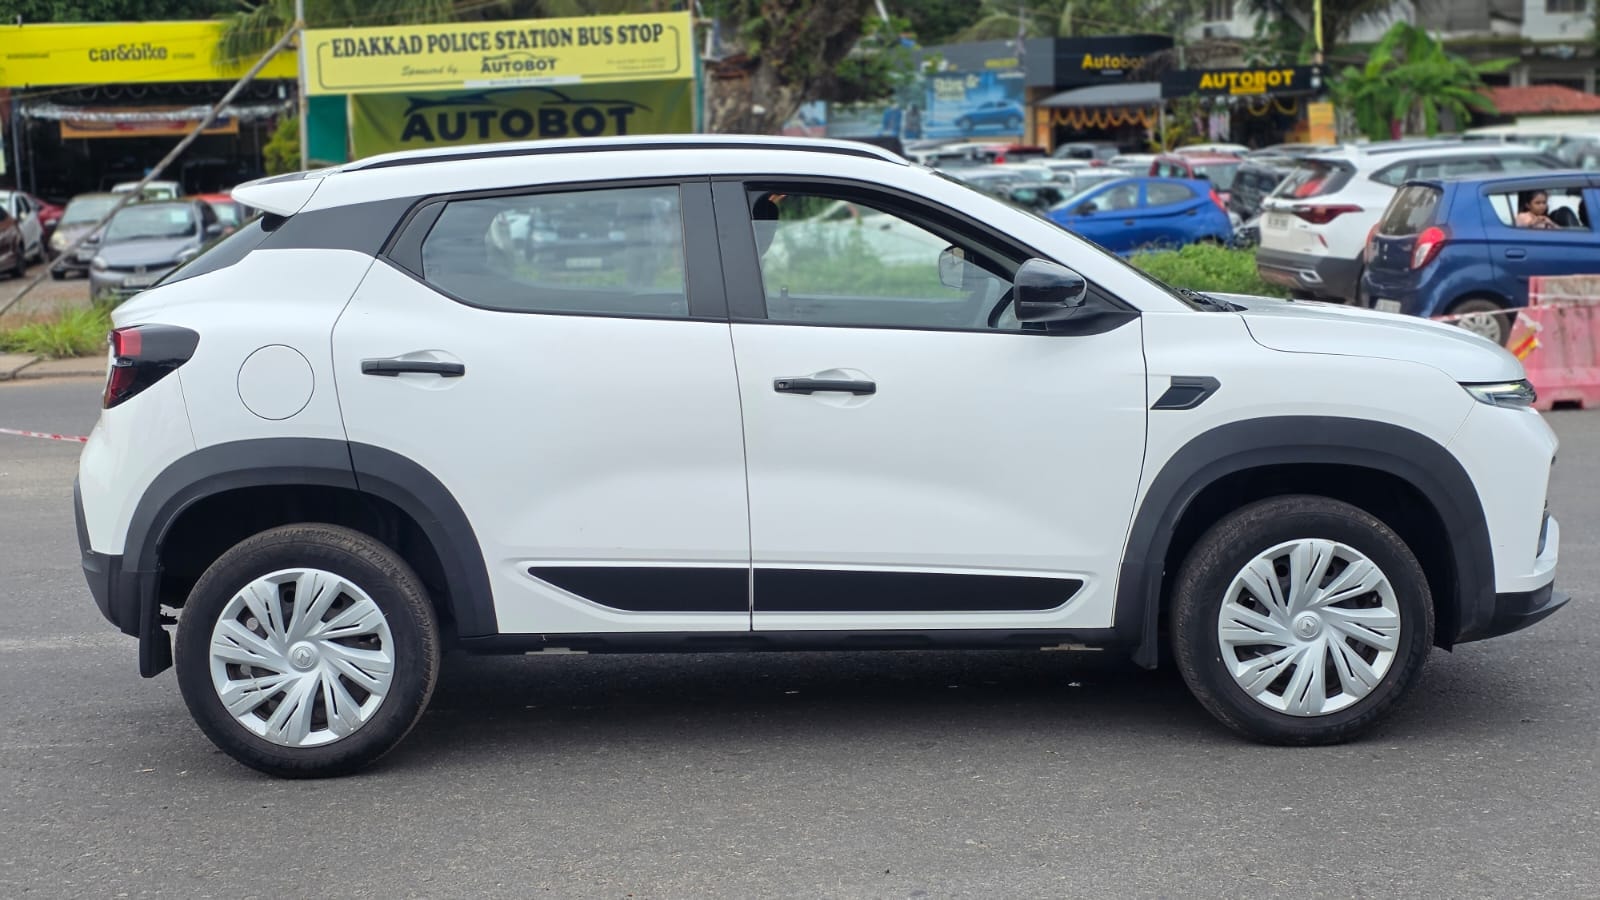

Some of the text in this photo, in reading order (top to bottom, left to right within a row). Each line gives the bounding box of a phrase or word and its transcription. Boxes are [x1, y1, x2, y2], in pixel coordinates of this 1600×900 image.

[332, 23, 664, 58] EDAKKAD POLICE STATION BUS STOP
[88, 43, 168, 62] car&bike
[481, 58, 557, 73] AUTOBOT
[1200, 69, 1295, 89] AUTOBOT
[401, 106, 635, 143] AUTOBOT
